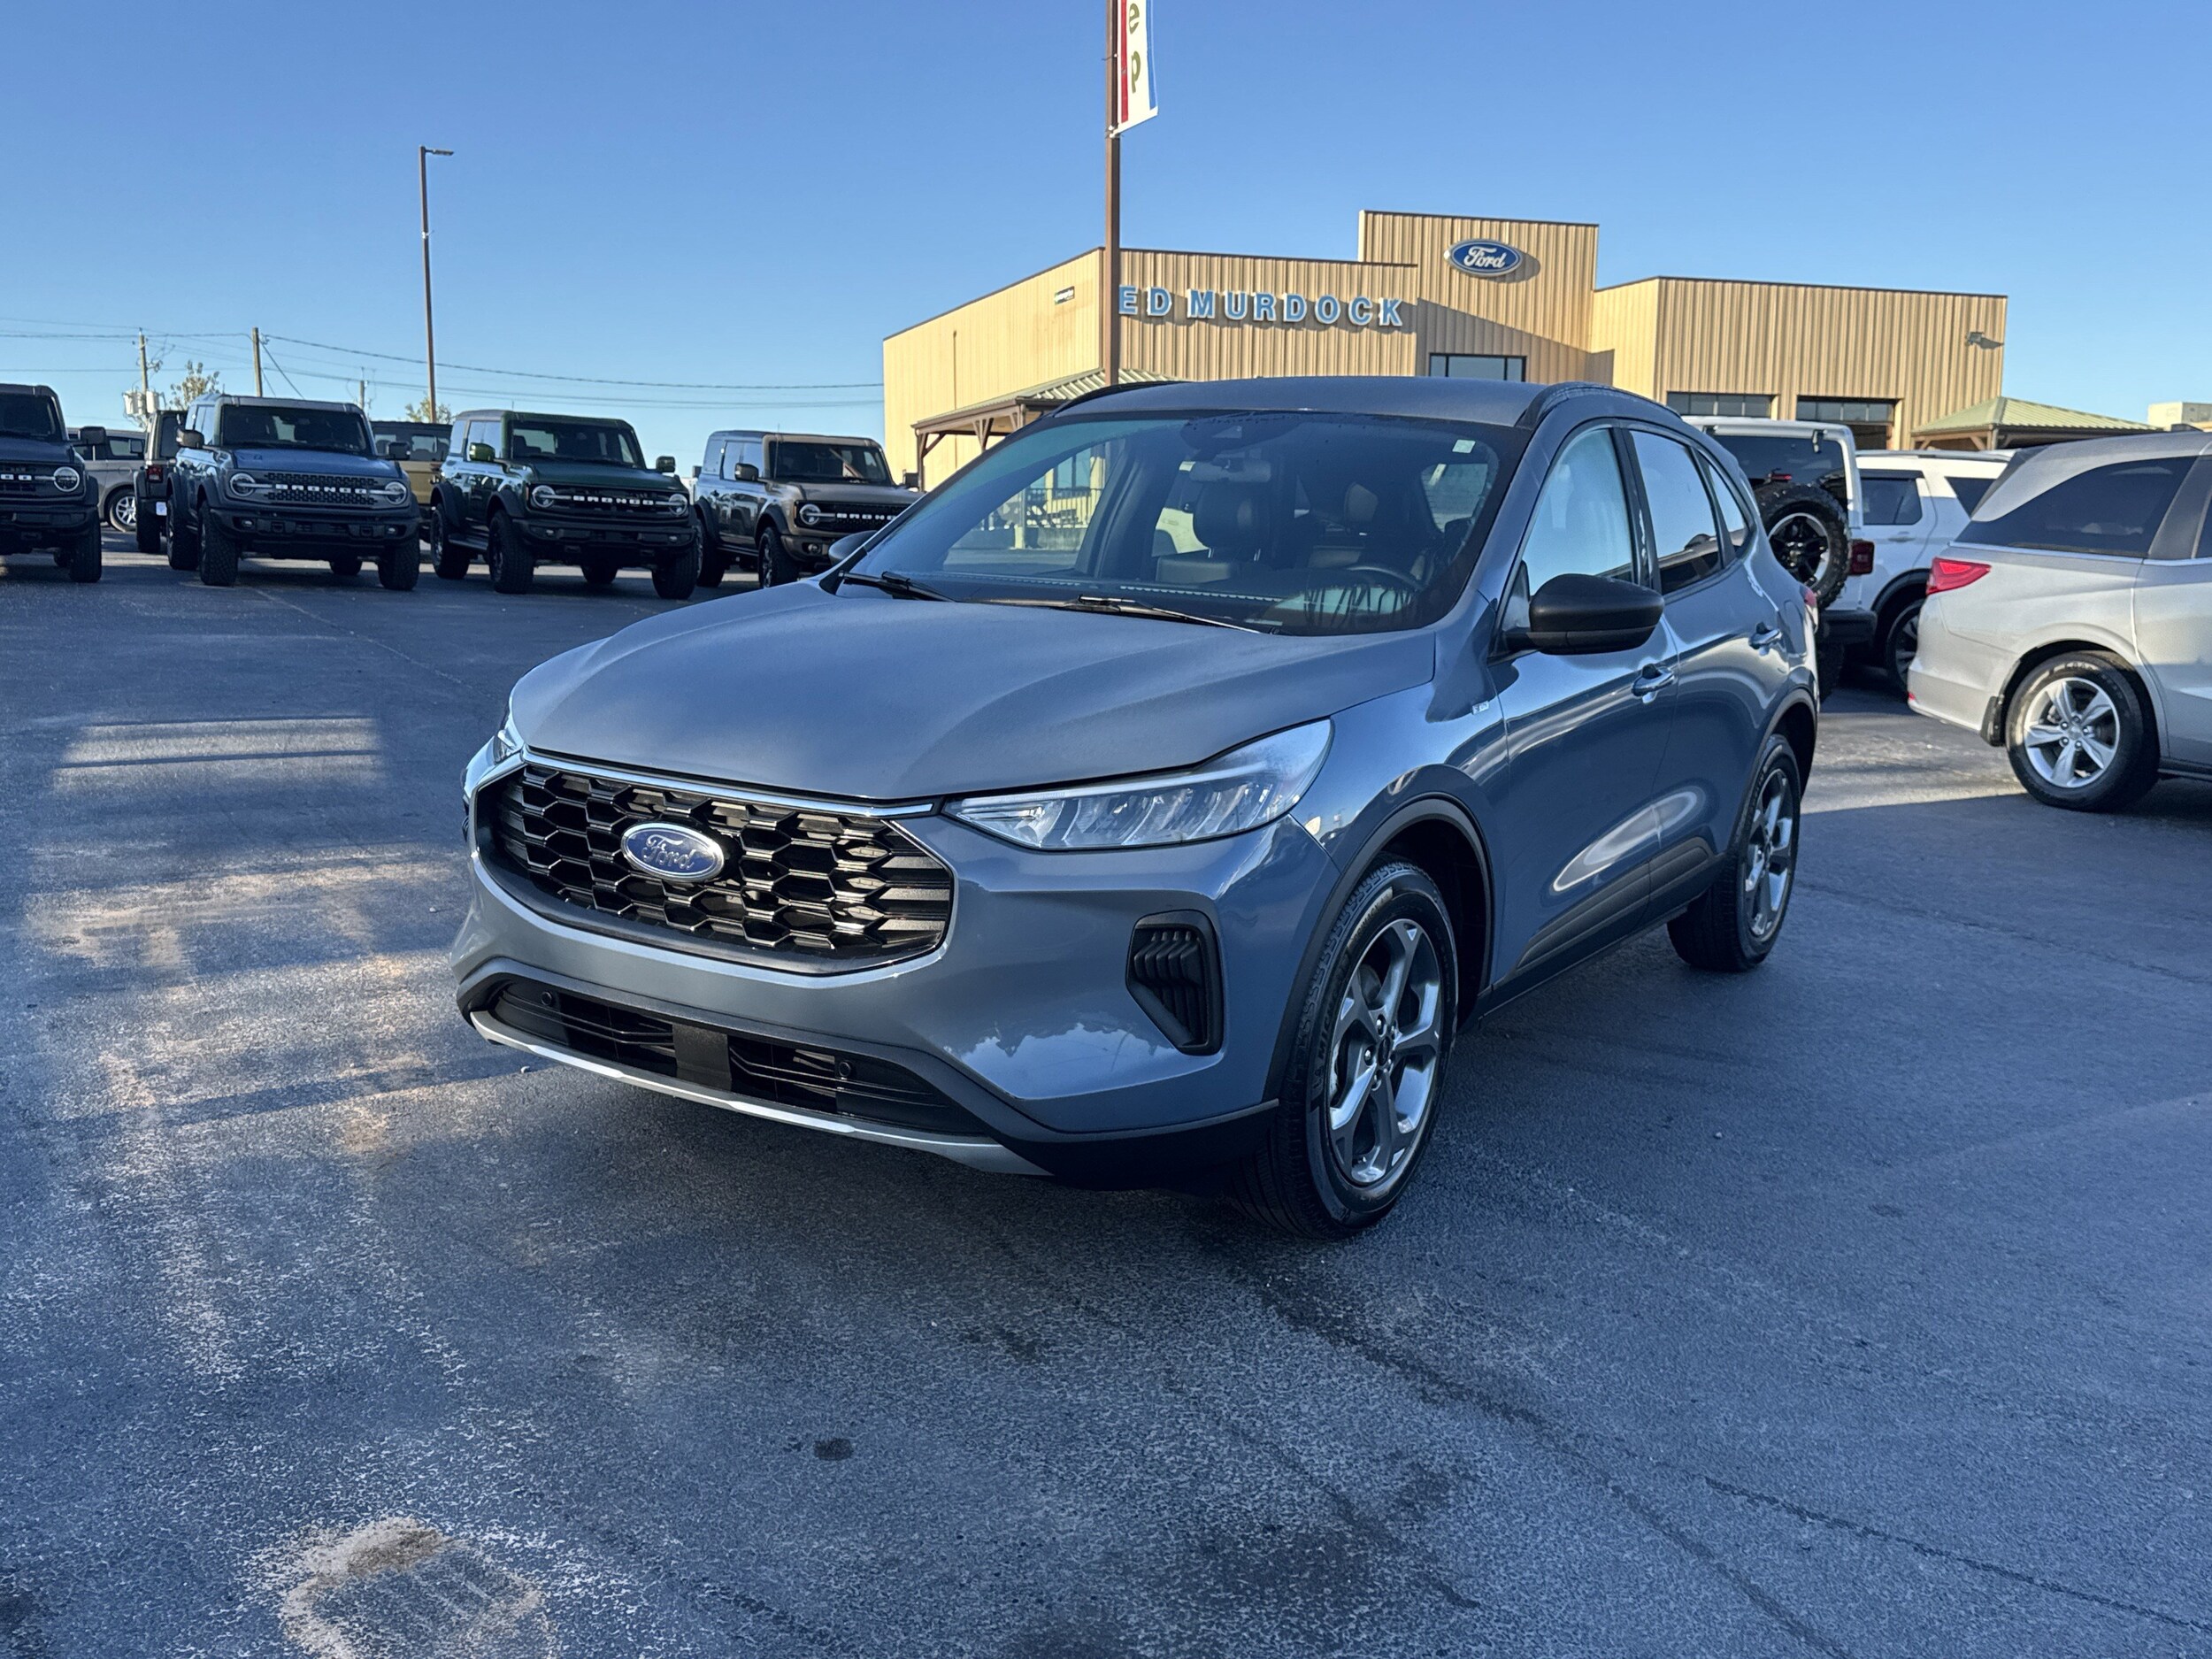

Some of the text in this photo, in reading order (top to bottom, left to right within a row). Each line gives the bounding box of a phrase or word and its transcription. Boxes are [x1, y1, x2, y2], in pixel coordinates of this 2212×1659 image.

[1463, 246, 1508, 269] Ford
[1118, 285, 1403, 326] ED MURDOCK
[275, 483, 368, 495] BRONCO
[573, 495, 654, 505] BRONCO
[836, 512, 897, 521] BRONC
[641, 834, 696, 871] Ford
